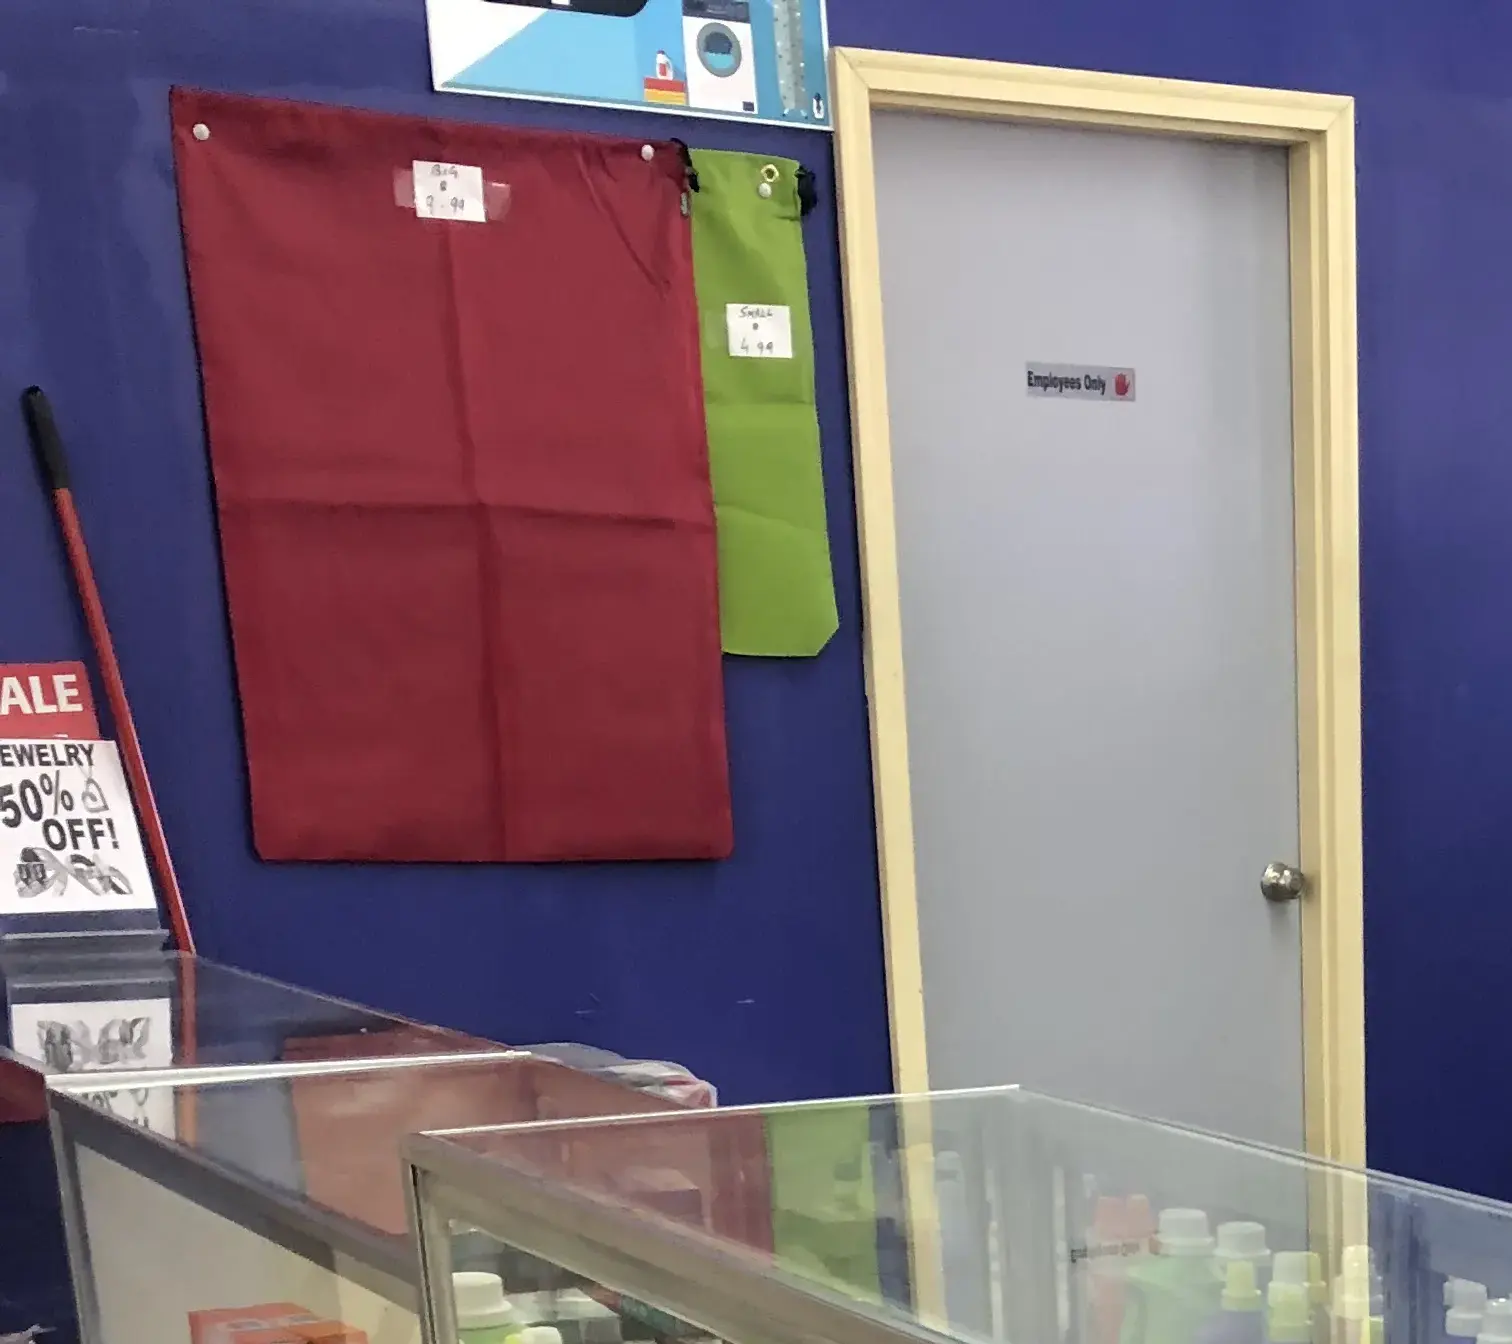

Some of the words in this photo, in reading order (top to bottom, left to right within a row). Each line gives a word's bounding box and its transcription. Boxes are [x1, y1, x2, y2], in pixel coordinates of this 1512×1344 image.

[1027, 370, 1081, 393] Employees
[1083, 374, 1106, 396] Only
[0, 674, 84, 715] ALE
[0, 743, 95, 768] EWELRY
[41, 818, 120, 852] OFF!
